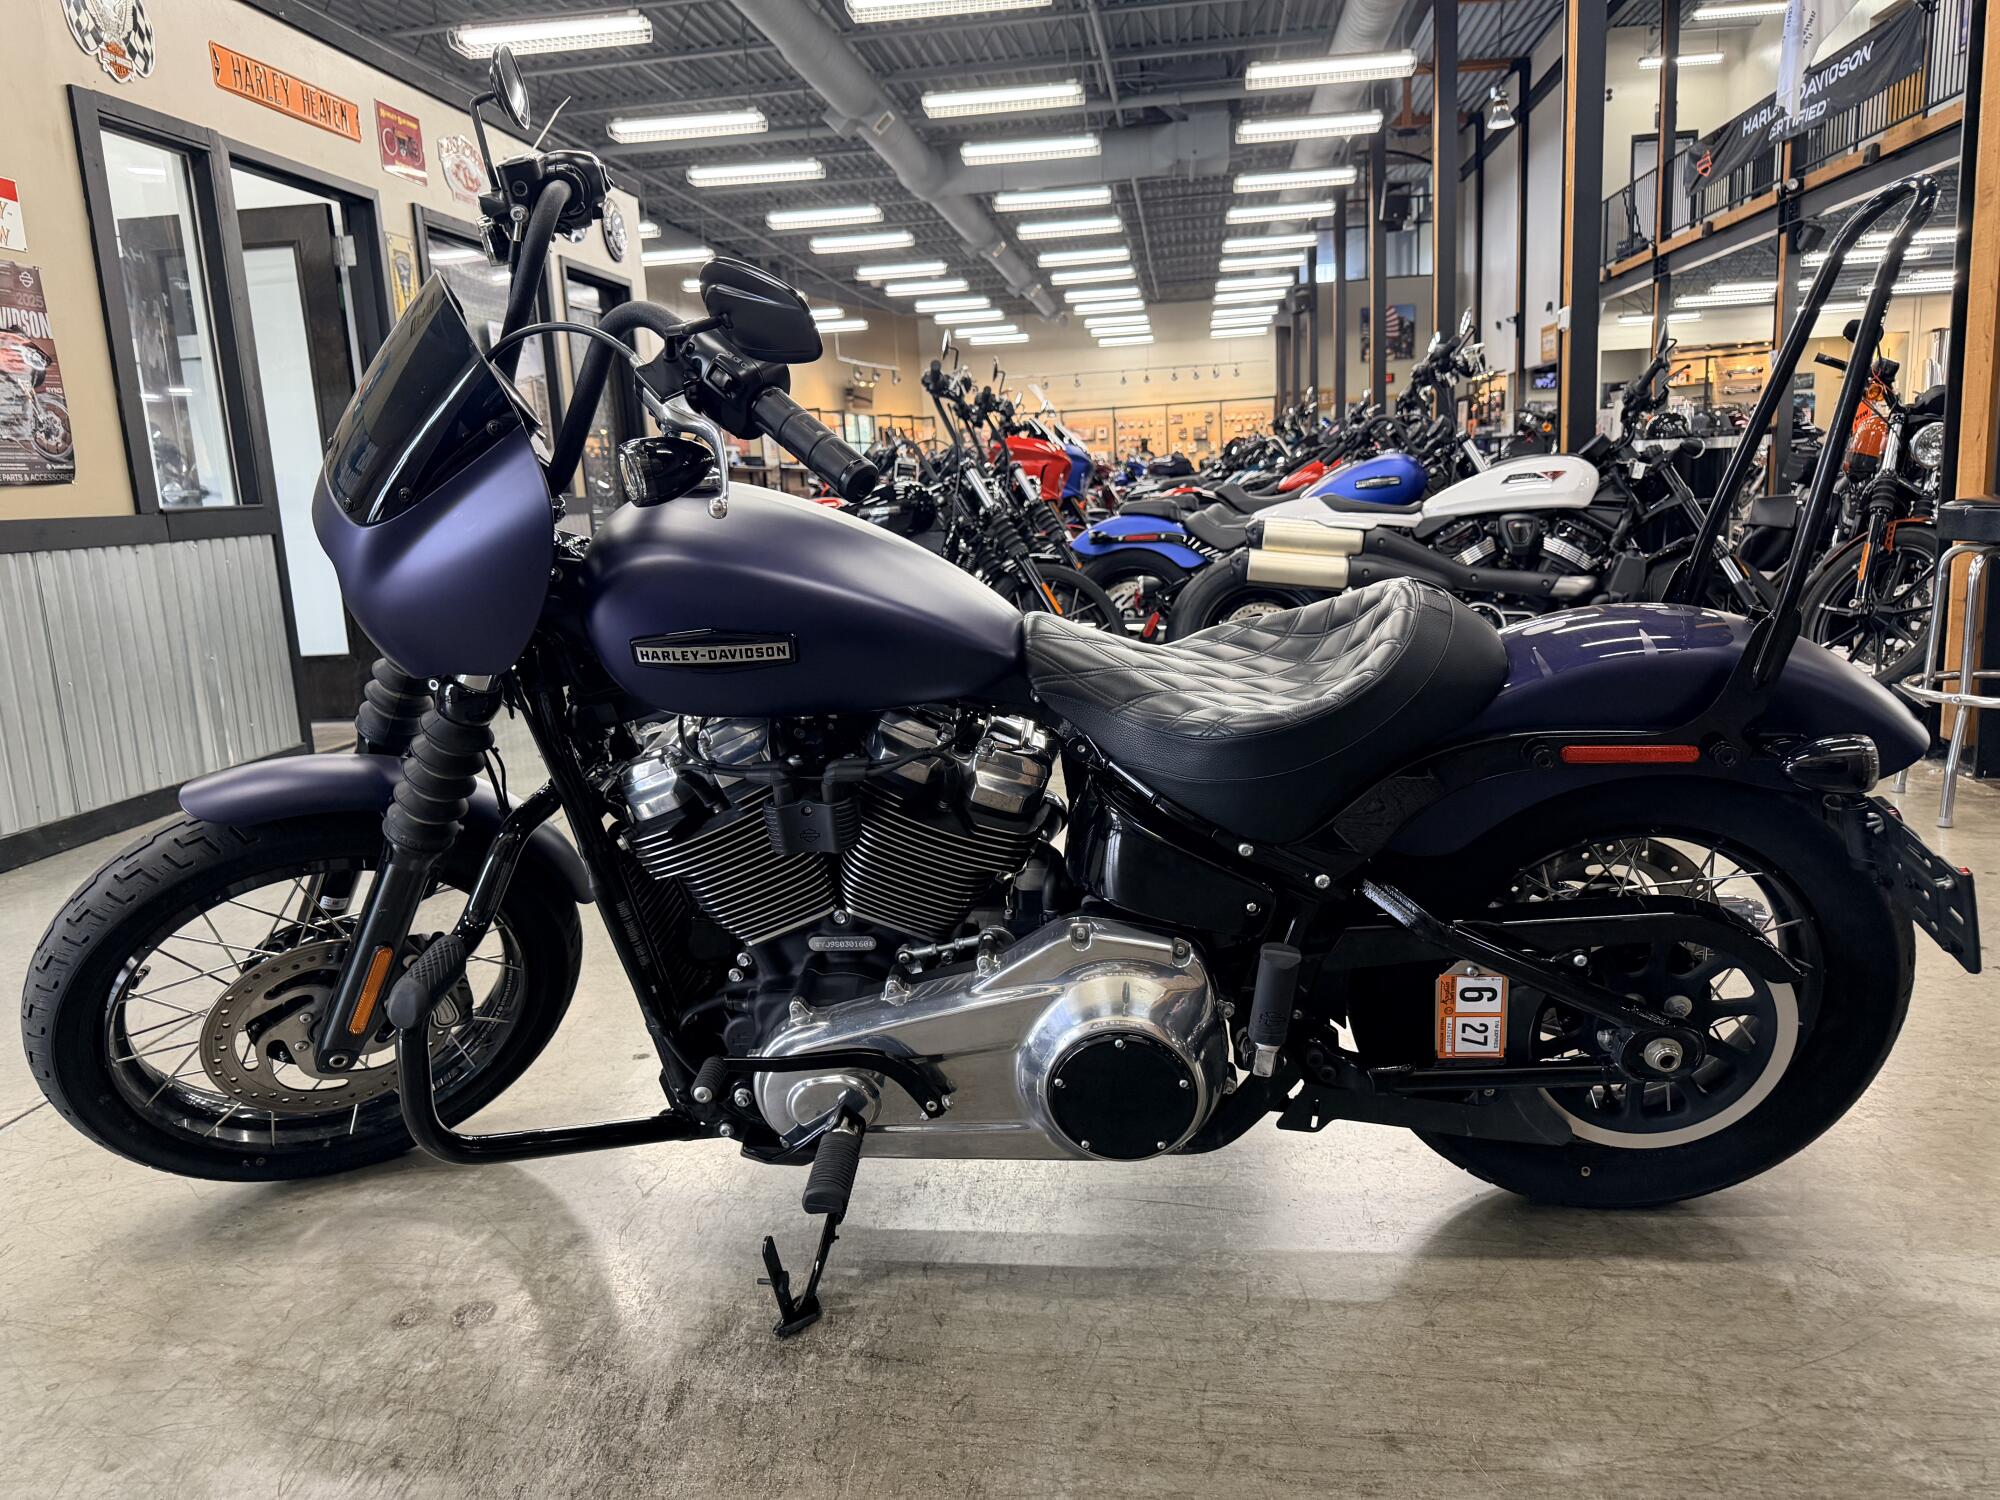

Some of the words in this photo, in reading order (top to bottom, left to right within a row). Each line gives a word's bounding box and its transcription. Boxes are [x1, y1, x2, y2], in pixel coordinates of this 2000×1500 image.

[231, 54, 290, 108] HARLEY
[300, 85, 349, 133] HEAVEN
[16, 292, 44, 308] 2025
[2, 473, 23, 481] PARTS
[30, 473, 74, 481] ACCESSORIES
[639, 645, 787, 662] HARLEY-DAVIDSON
[1458, 986, 1498, 1003] 6
[1461, 1022, 1489, 1047] 27
